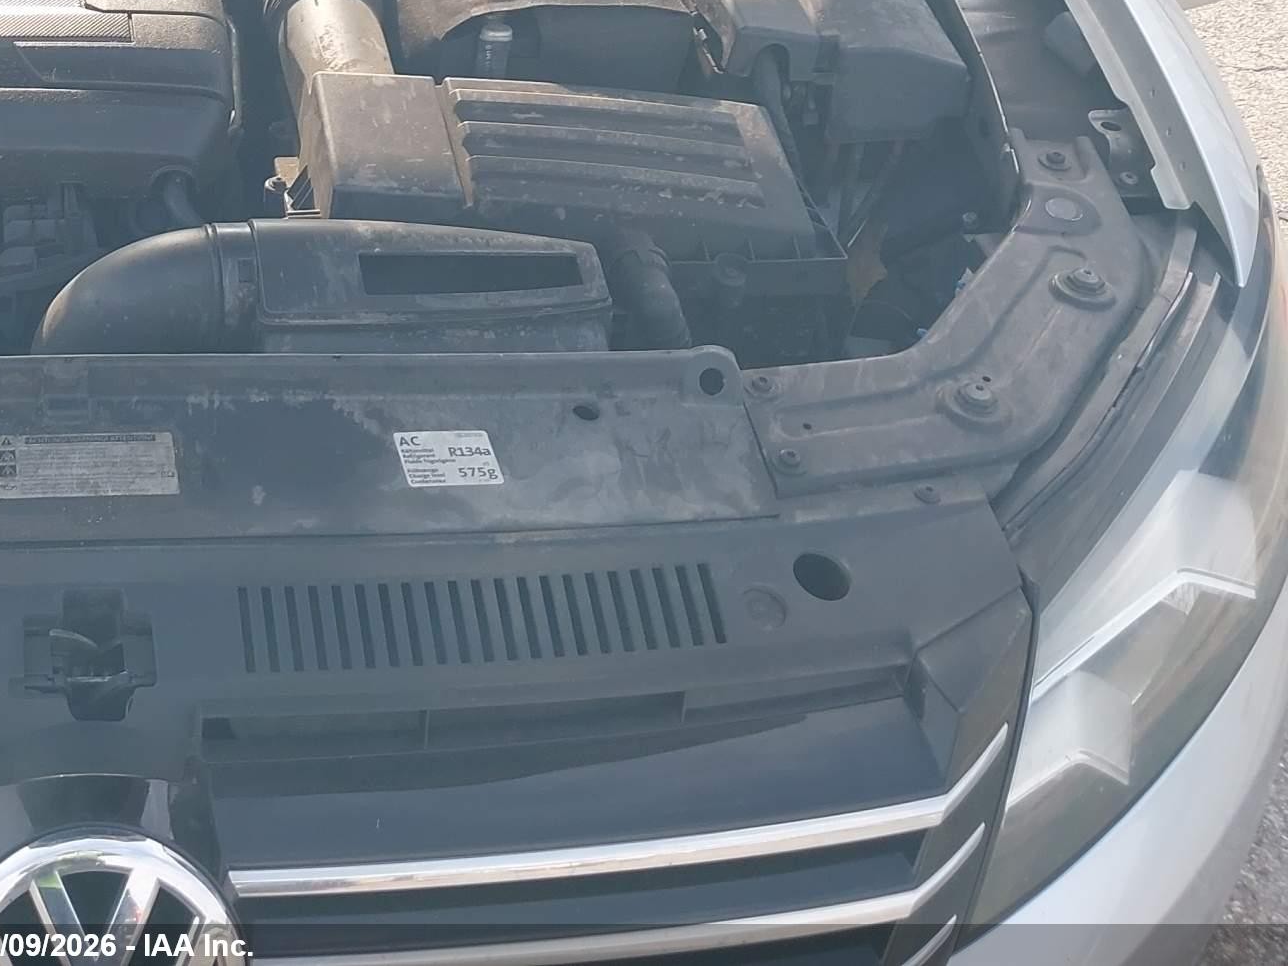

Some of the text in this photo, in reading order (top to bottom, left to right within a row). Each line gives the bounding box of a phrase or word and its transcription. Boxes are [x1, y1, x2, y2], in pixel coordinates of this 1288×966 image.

[399, 435, 421, 447] AC
[448, 446, 491, 457] R134a
[457, 467, 498, 480] 575g
